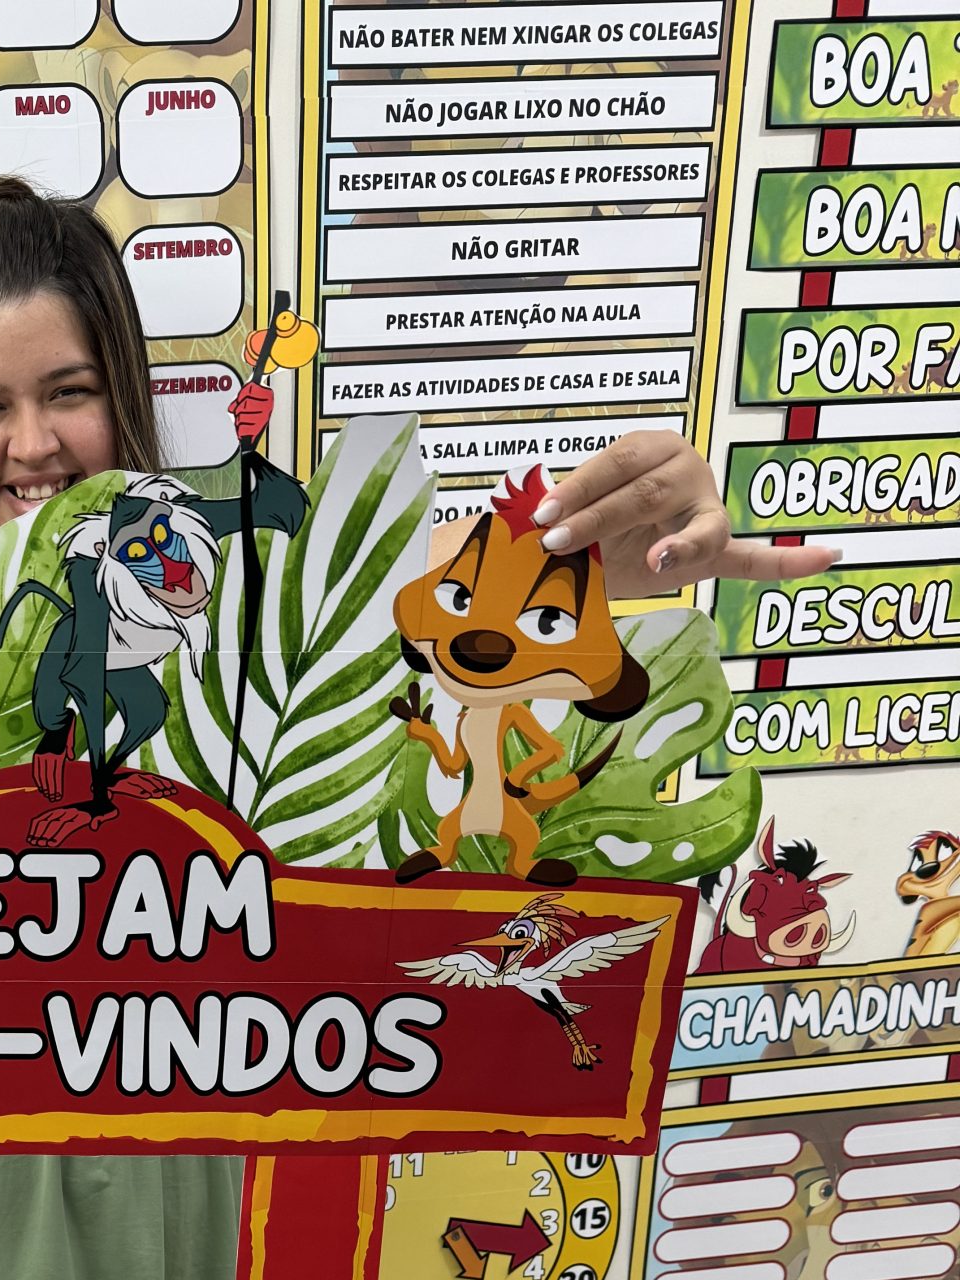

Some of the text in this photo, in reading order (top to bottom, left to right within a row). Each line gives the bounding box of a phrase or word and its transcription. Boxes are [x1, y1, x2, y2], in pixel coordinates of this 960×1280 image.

[340, 21, 719, 48] NÃO BATER NEM XINGAR OS COLEGAS
[810, 32, 932, 108] BOA
[15, 95, 71, 116] MAIO
[145, 89, 216, 116] JUNHO
[386, 92, 665, 127] NÃO JOGAR LIXO NO CHÃO
[340, 164, 699, 191] RESPEITAR OS COLEGAS E PROFESSORES
[803, 183, 924, 257] BOA
[134, 238, 233, 261] SETEMBRO
[452, 236, 579, 260] NÃO GRITAR
[387, 304, 640, 330] PRESTAR ATENÇÃO NA AULA
[777, 324, 899, 395] POR
[151, 375, 232, 395] EZEMBRO
[333, 370, 680, 400] FAZER AS ATIVIDADES DE CASA E DE SALA
[434, 442, 478, 458] SALA
[485, 440, 538, 456] LIMPA
[545, 439, 553, 453] E
[724, 697, 830, 755] COM
[389, 1152, 424, 1178] 11
[529, 1169, 552, 1197] 2
[540, 1209, 559, 1236] 3
[573, 1206, 607, 1231] 15
[523, 1254, 544, 1280] 4
